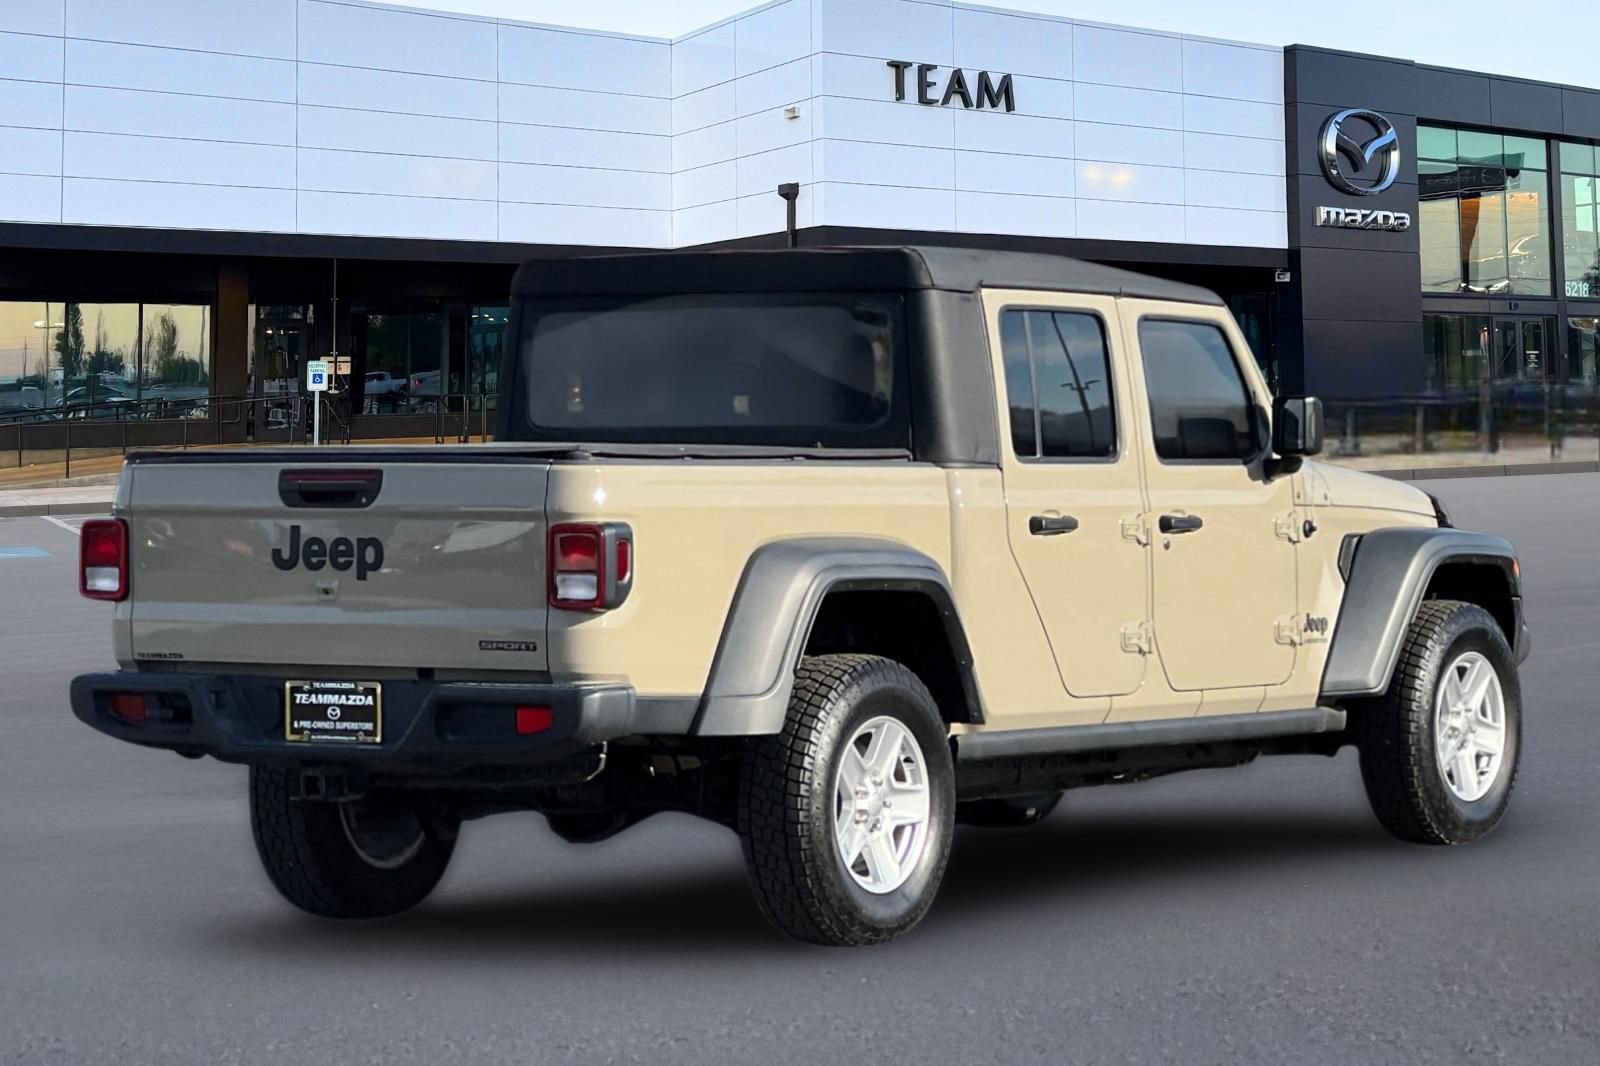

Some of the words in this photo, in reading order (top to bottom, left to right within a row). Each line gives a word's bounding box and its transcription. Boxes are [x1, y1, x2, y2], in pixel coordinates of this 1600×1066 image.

[886, 60, 1016, 113] TEAM
[1313, 205, 1411, 231] mazda
[1565, 281, 1589, 297] 6218
[271, 525, 385, 581] Jeep
[1303, 612, 1328, 636] Jeep
[479, 640, 537, 651] SPORT
[293, 693, 375, 706] TEAMMAZDA
[299, 720, 335, 730] PRE-OWNED
[335, 721, 374, 731] SUPERSTORE
